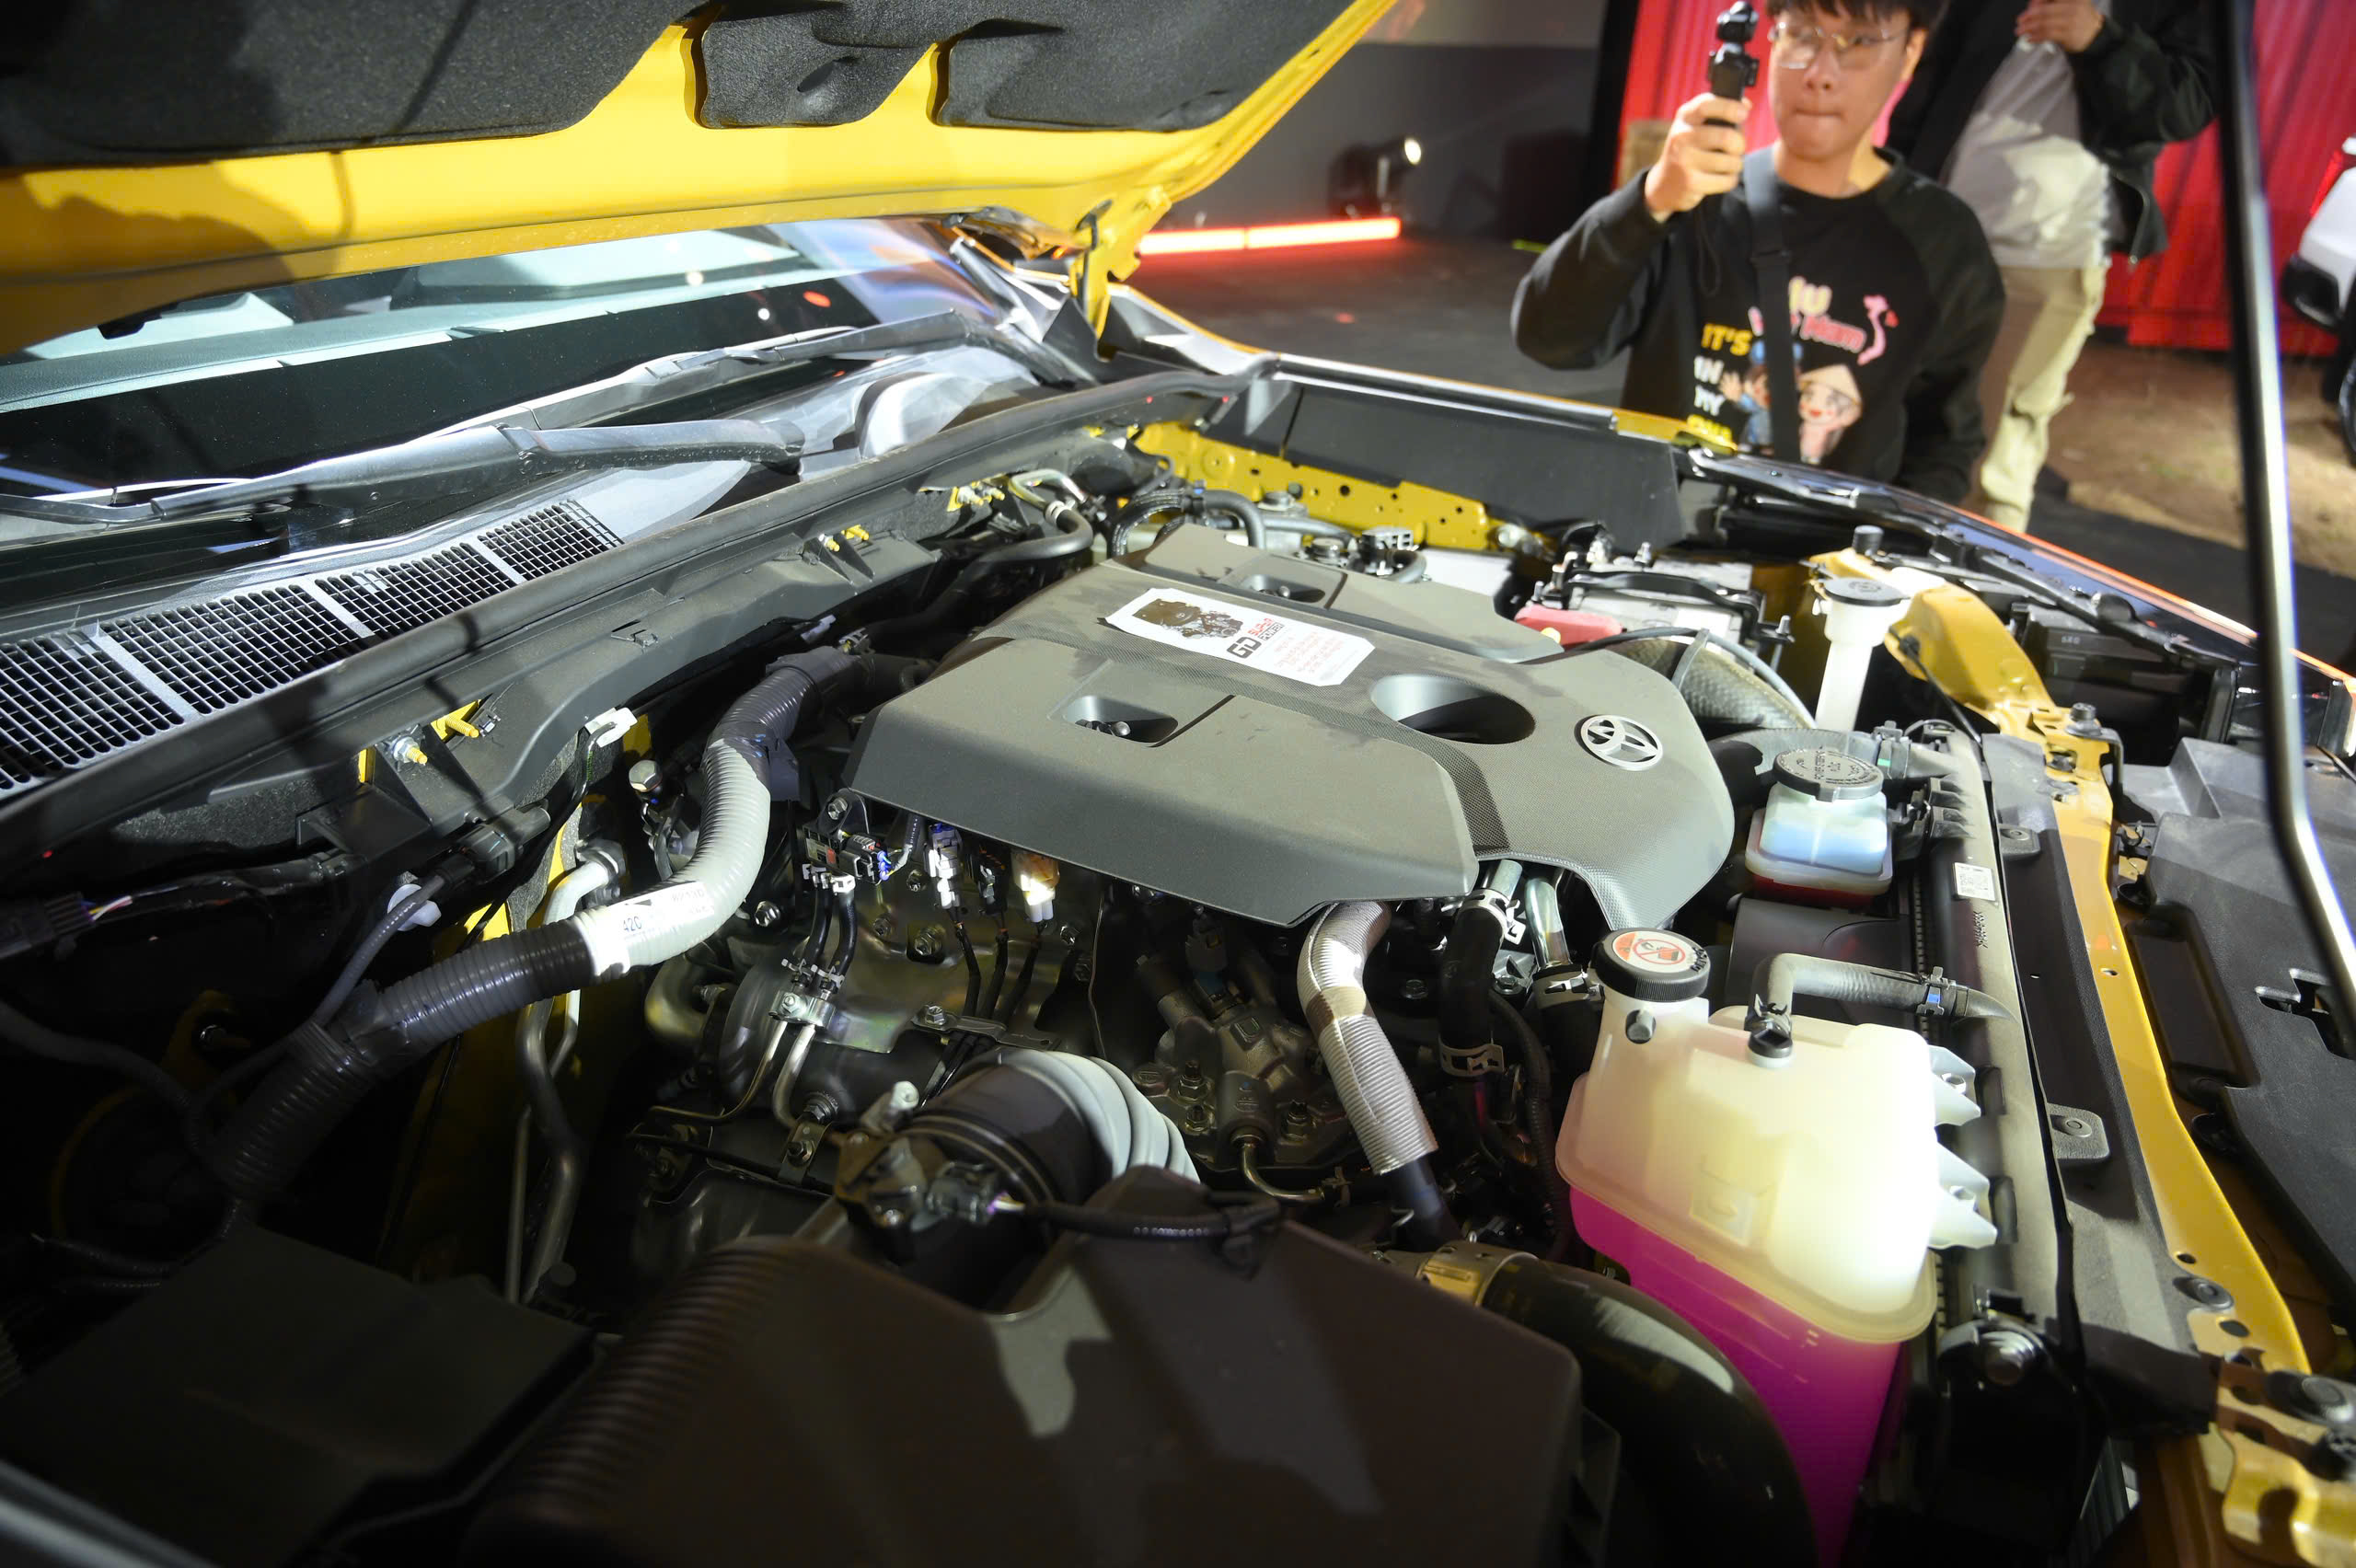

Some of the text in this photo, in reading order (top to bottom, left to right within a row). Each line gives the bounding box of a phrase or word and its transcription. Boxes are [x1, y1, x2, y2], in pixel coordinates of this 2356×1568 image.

[1702, 323, 1752, 356] IT'S
[1693, 355, 1725, 385] IN
[1693, 385, 1727, 416] MY
[1258, 622, 1285, 640] POWER
[1227, 636, 1263, 659] GD
